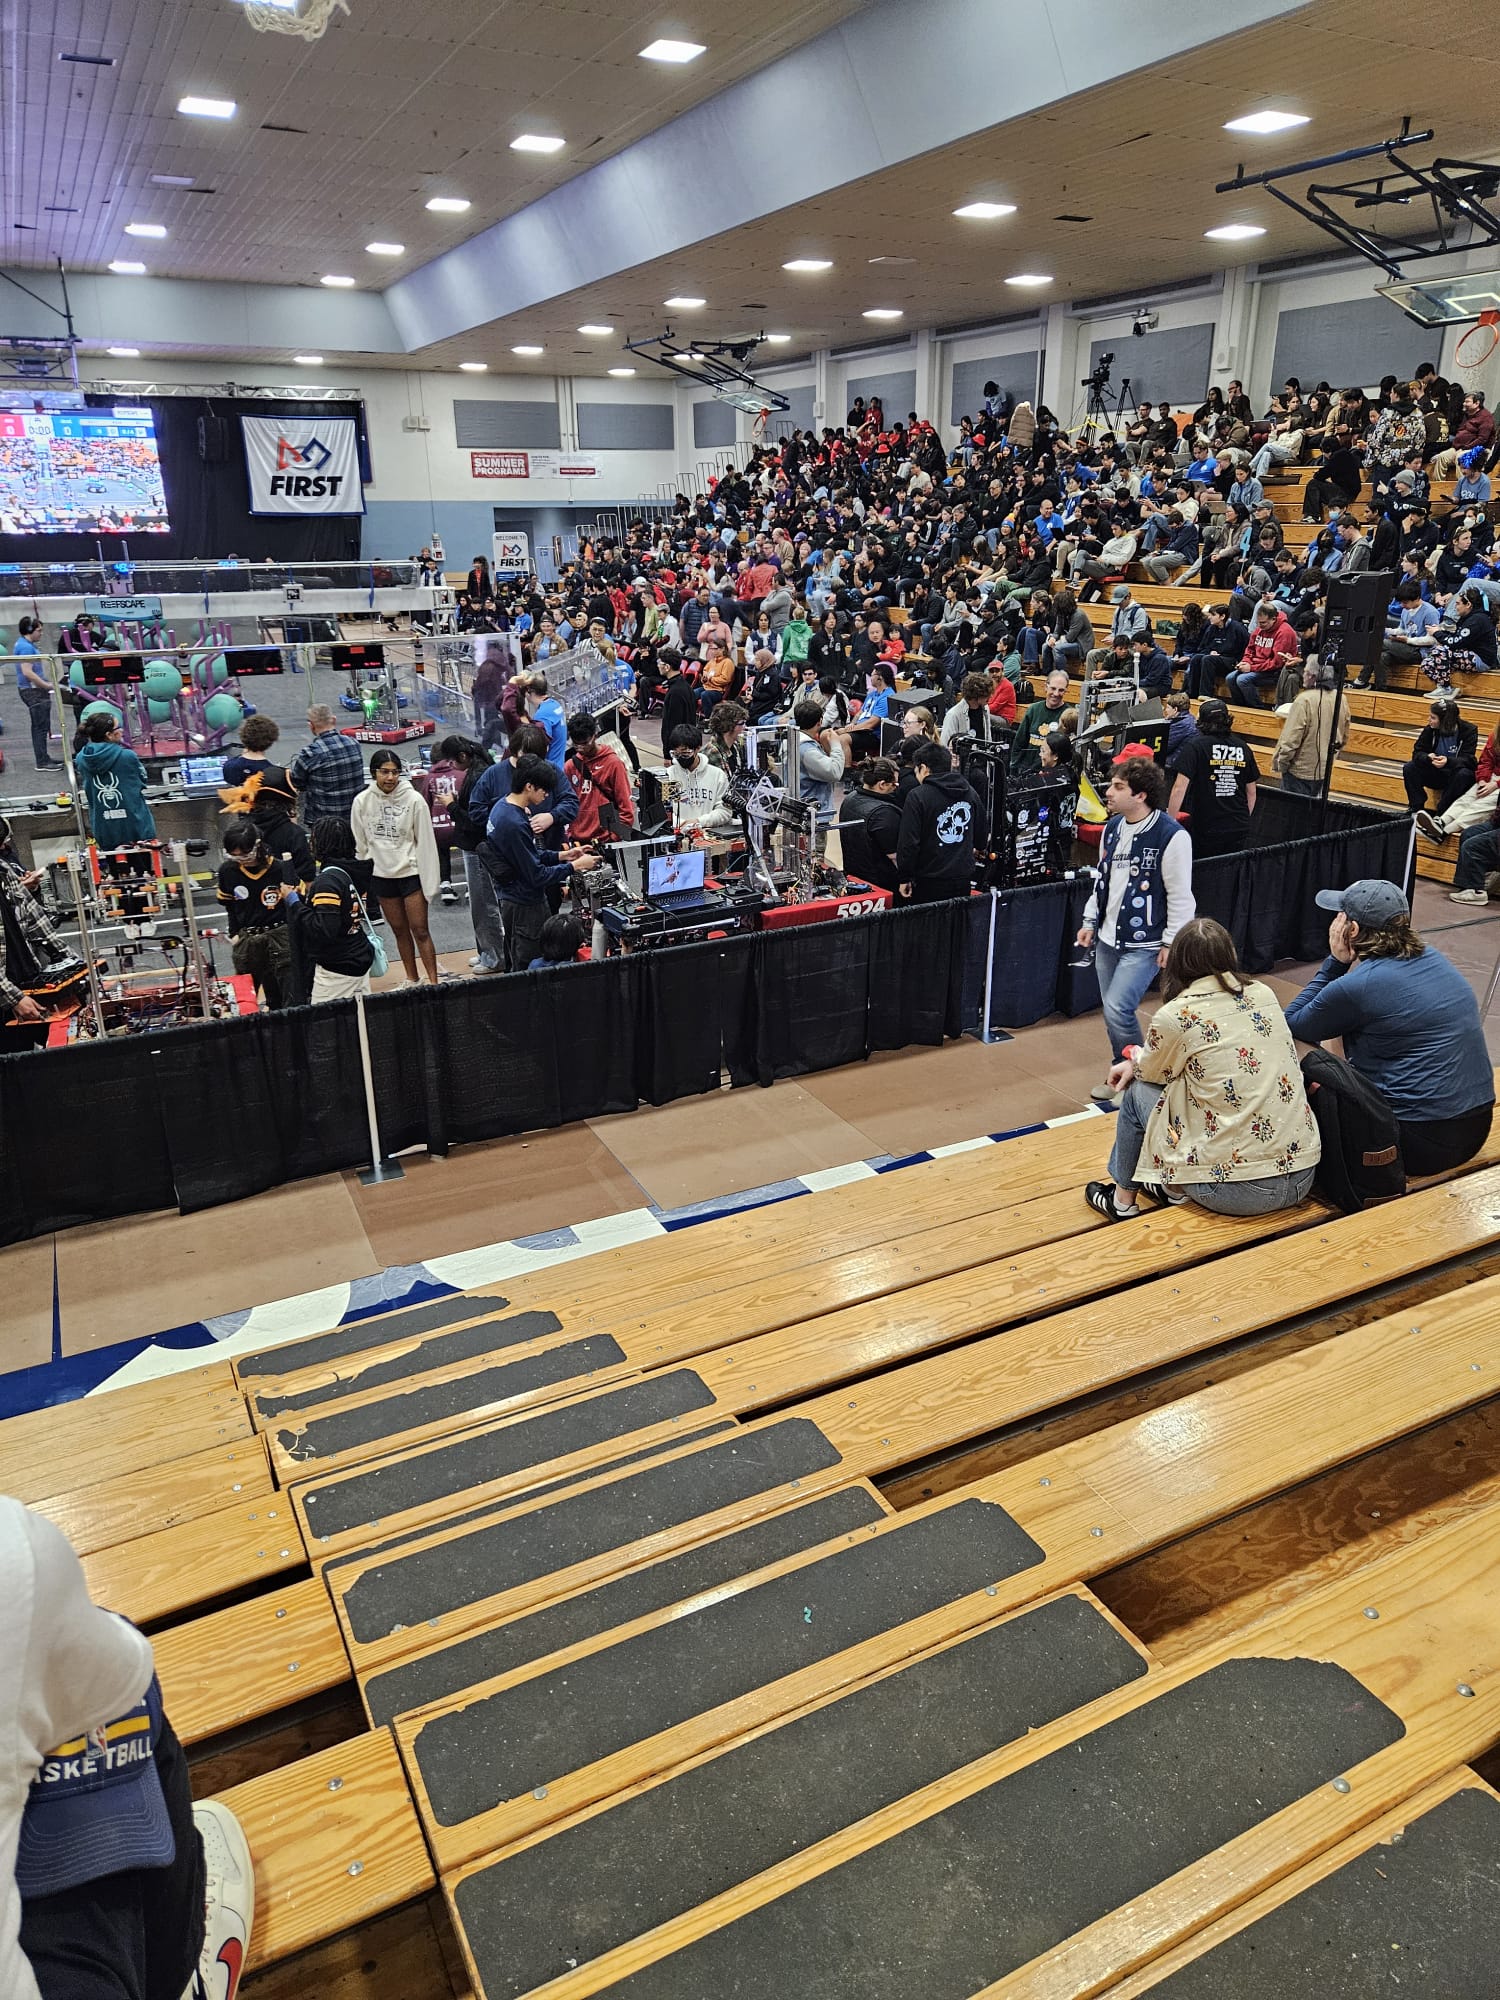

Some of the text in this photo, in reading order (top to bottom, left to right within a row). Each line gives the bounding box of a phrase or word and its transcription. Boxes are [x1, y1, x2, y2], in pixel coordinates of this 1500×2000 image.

[475, 458, 525, 467] SUMMER
[475, 467, 526, 475] PROGRAMS
[270, 475, 343, 496] FIRST
[501, 558, 526, 566] FIRST
[100, 600, 146, 608] REEFSCAPE
[1212, 745, 1244, 761] 5728
[837, 898, 885, 918] 5924
